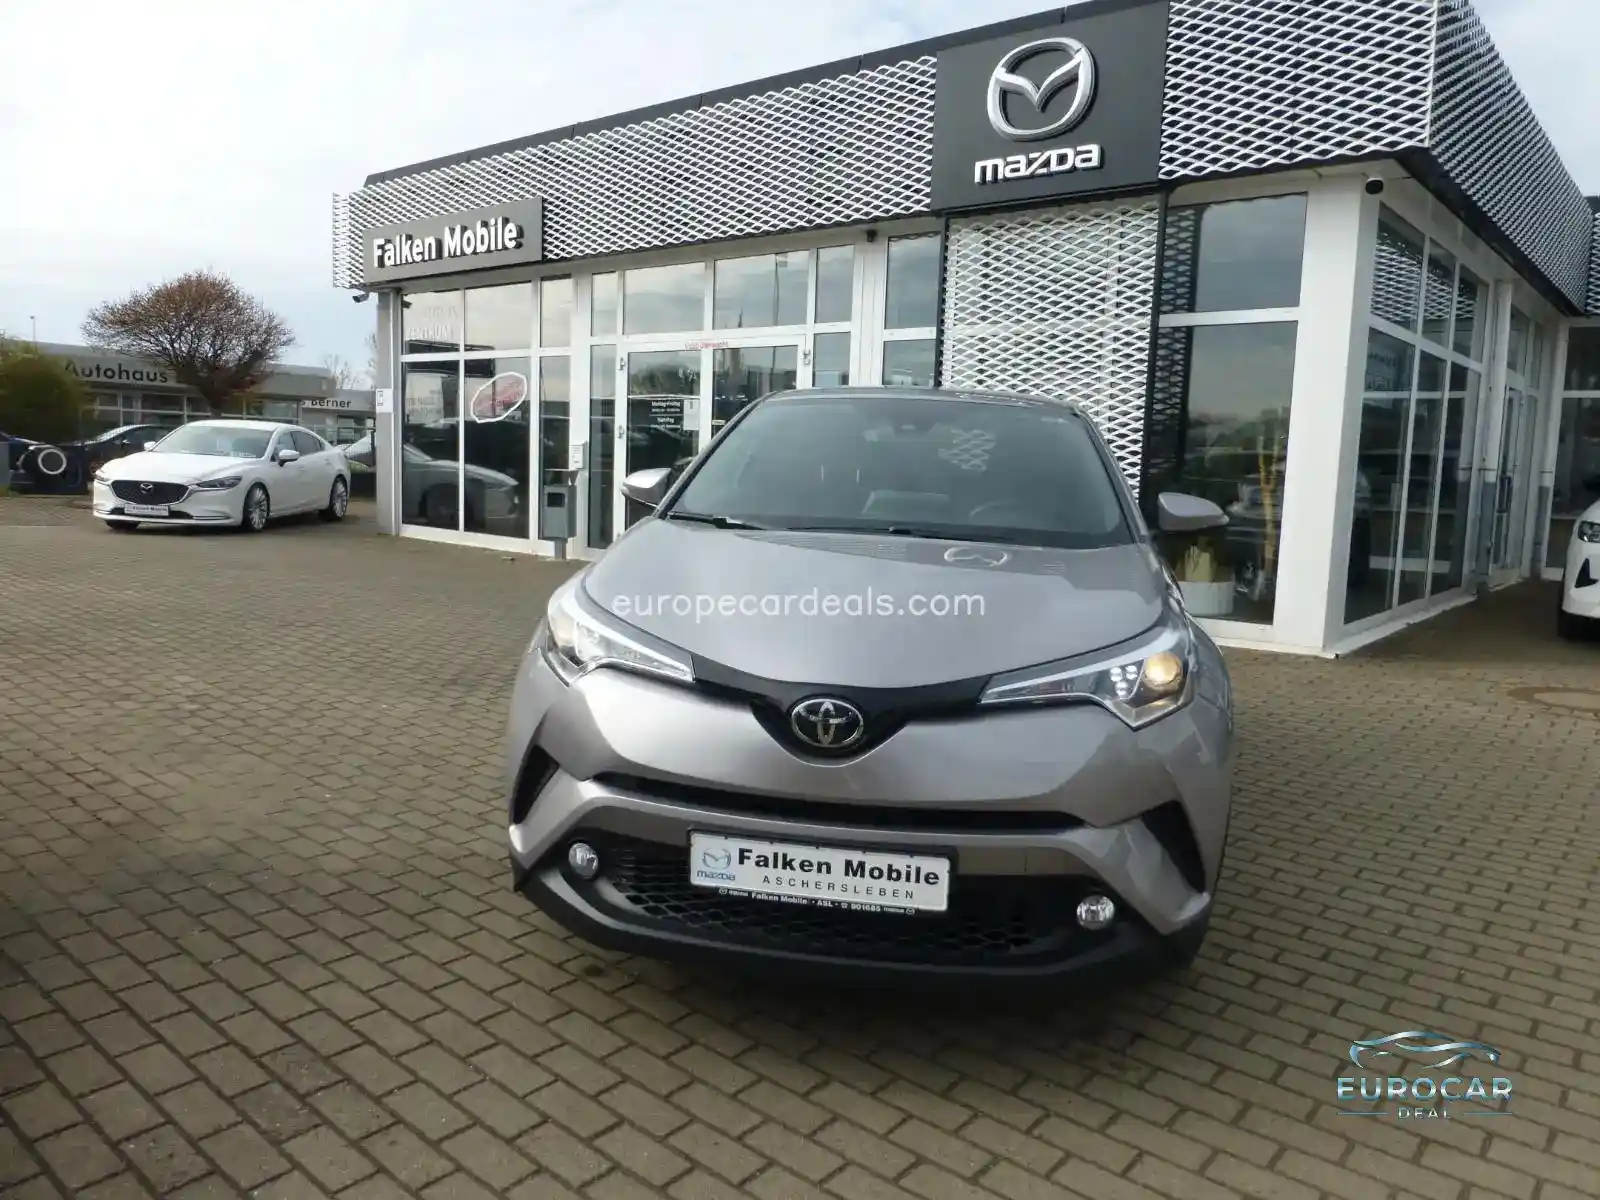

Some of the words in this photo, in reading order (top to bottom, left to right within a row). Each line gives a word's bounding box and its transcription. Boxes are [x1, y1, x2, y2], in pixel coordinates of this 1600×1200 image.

[974, 144, 1101, 183] mazda
[372, 232, 437, 268] Falken
[443, 217, 518, 258] Mobile
[64, 359, 168, 383] Autohaus
[738, 847, 832, 875] Falken
[844, 859, 940, 886] Mobile
[751, 892, 779, 902] Falken
[780, 895, 808, 905] Mobile
[763, 875, 914, 899] ASCHERSLEBEN
